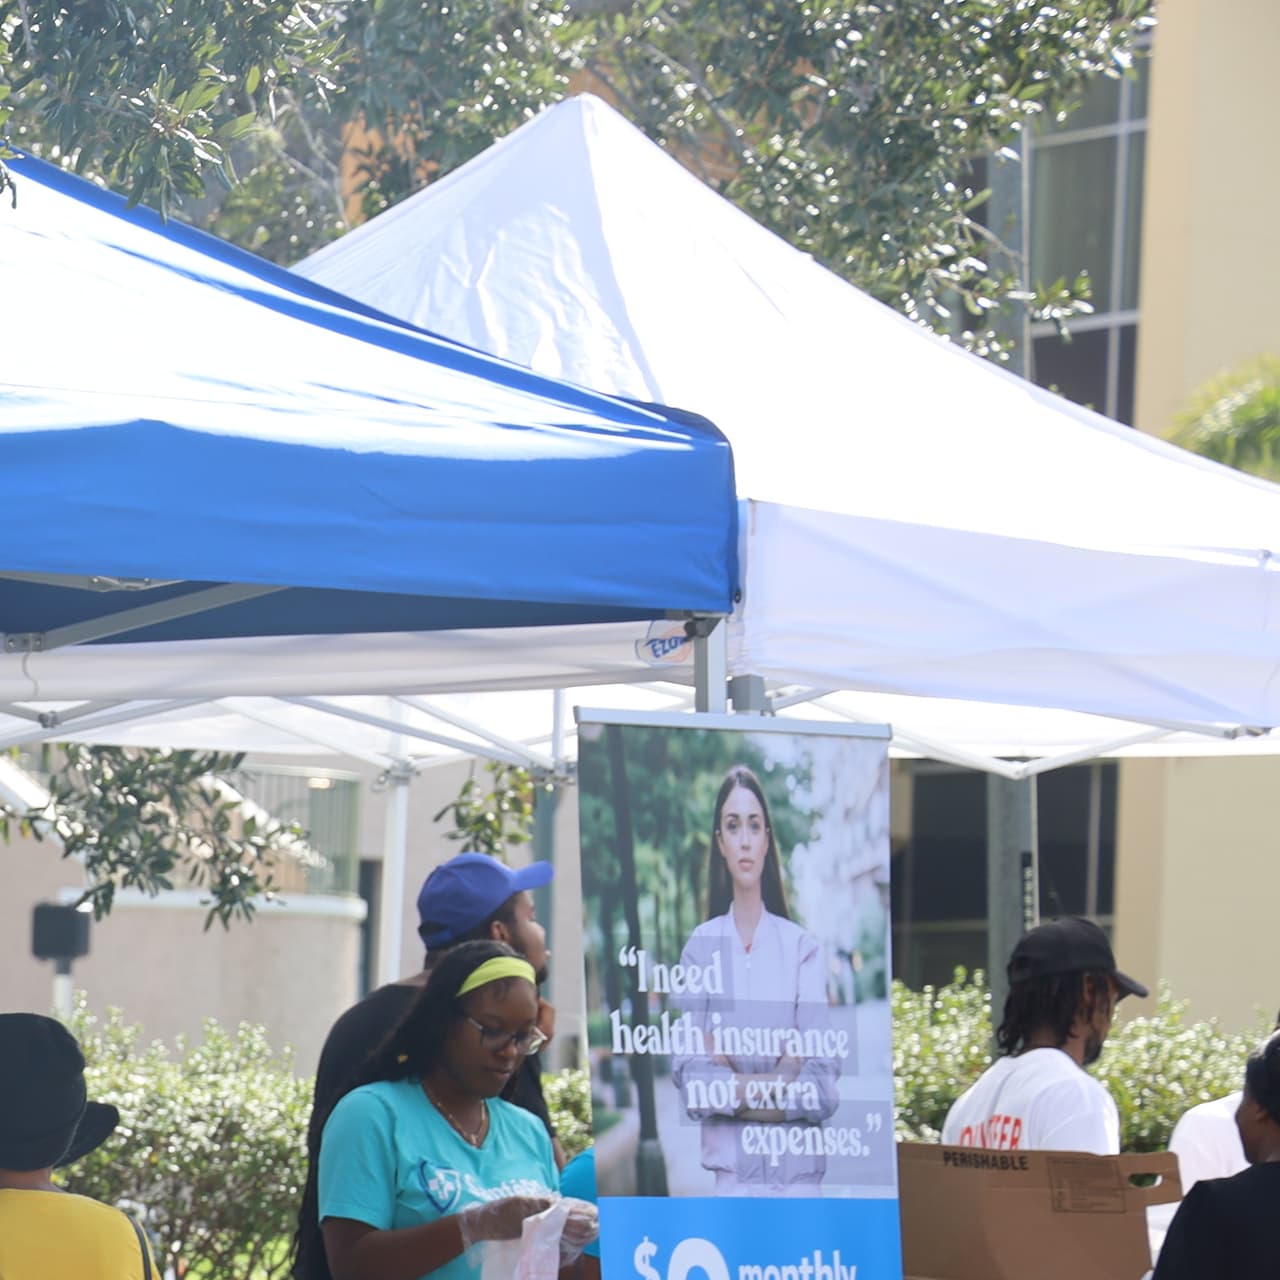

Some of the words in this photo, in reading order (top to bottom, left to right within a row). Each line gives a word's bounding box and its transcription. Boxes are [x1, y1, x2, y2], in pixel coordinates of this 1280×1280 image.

[652, 950, 725, 996] need
[609, 1010, 706, 1055] health
[713, 1013, 849, 1058] insurance
[687, 1078, 741, 1110] not
[745, 1075, 820, 1110] extra
[943, 1151, 1029, 1170] PERISHABLE
